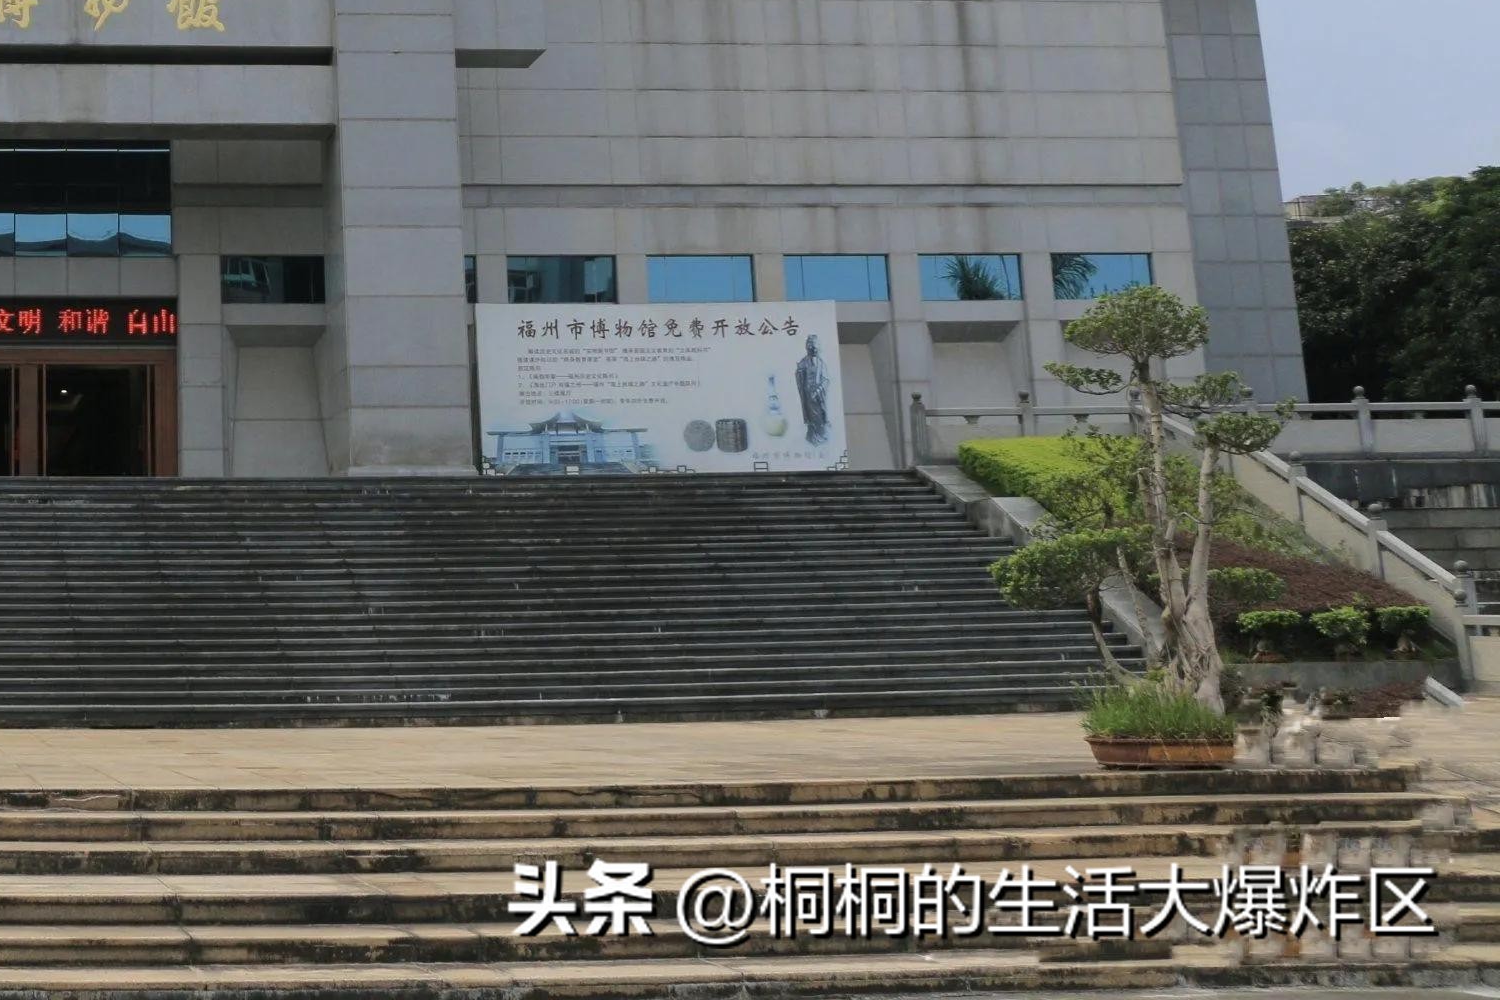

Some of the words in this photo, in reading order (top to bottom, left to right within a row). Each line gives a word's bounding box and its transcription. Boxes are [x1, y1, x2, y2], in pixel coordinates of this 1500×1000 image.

[58, 308, 110, 334] 和谐
[517, 316, 800, 340] 福州市博物馆免费开放公告
